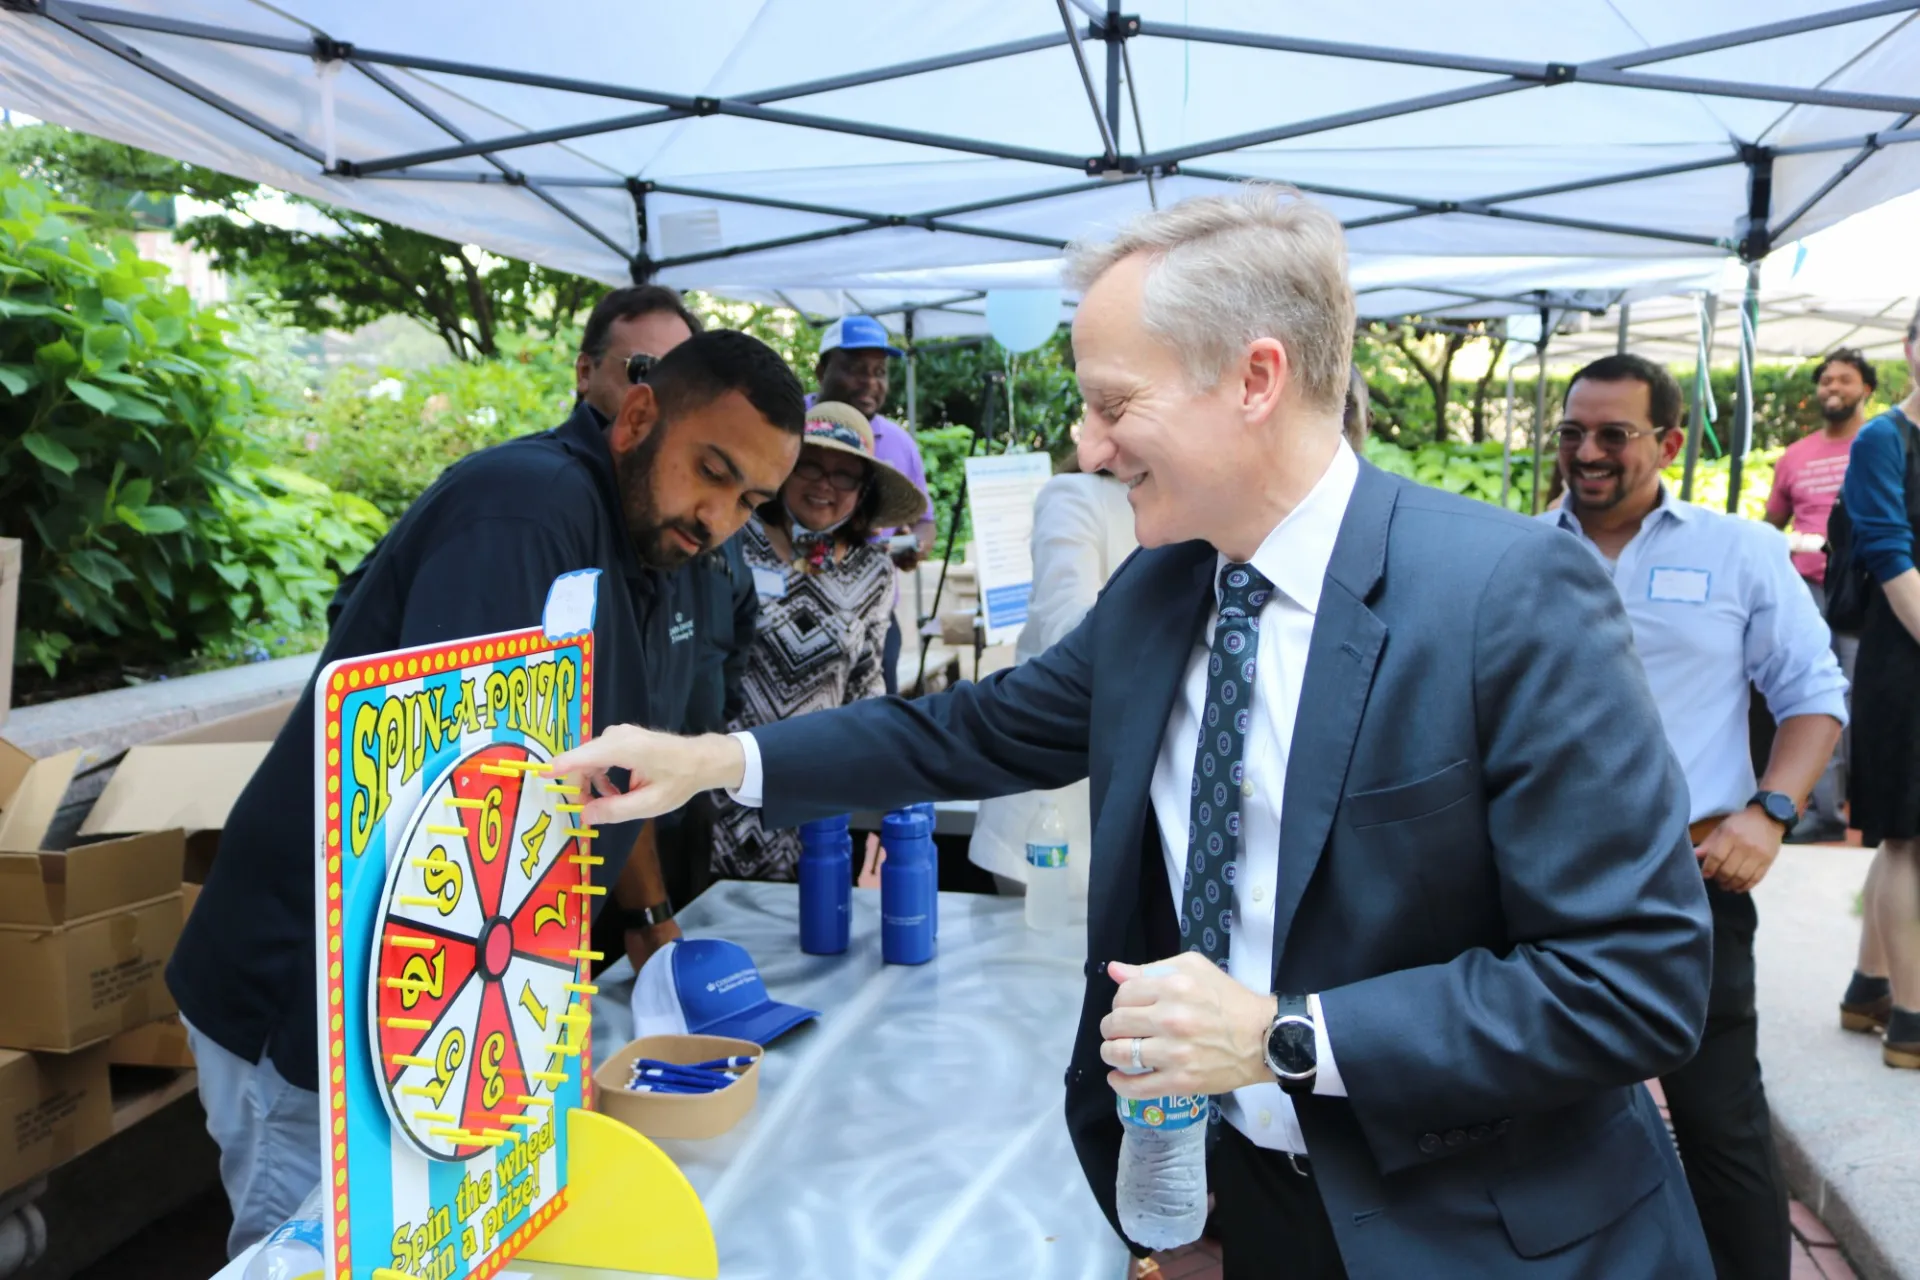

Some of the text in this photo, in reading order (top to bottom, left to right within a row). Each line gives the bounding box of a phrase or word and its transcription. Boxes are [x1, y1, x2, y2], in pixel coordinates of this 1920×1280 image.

[478, 786, 503, 864] 6
[520, 810, 552, 880] 4
[424, 844, 463, 916] 8
[534, 891, 567, 936] 7
[401, 945, 446, 1010] 2
[518, 978, 549, 1032] 1
[425, 1026, 466, 1110] 5
[480, 1030, 505, 1111] 3
[390, 1105, 556, 1276] Spin the wheel
[461, 1225, 478, 1261] a
[481, 1155, 541, 1255] prize!
